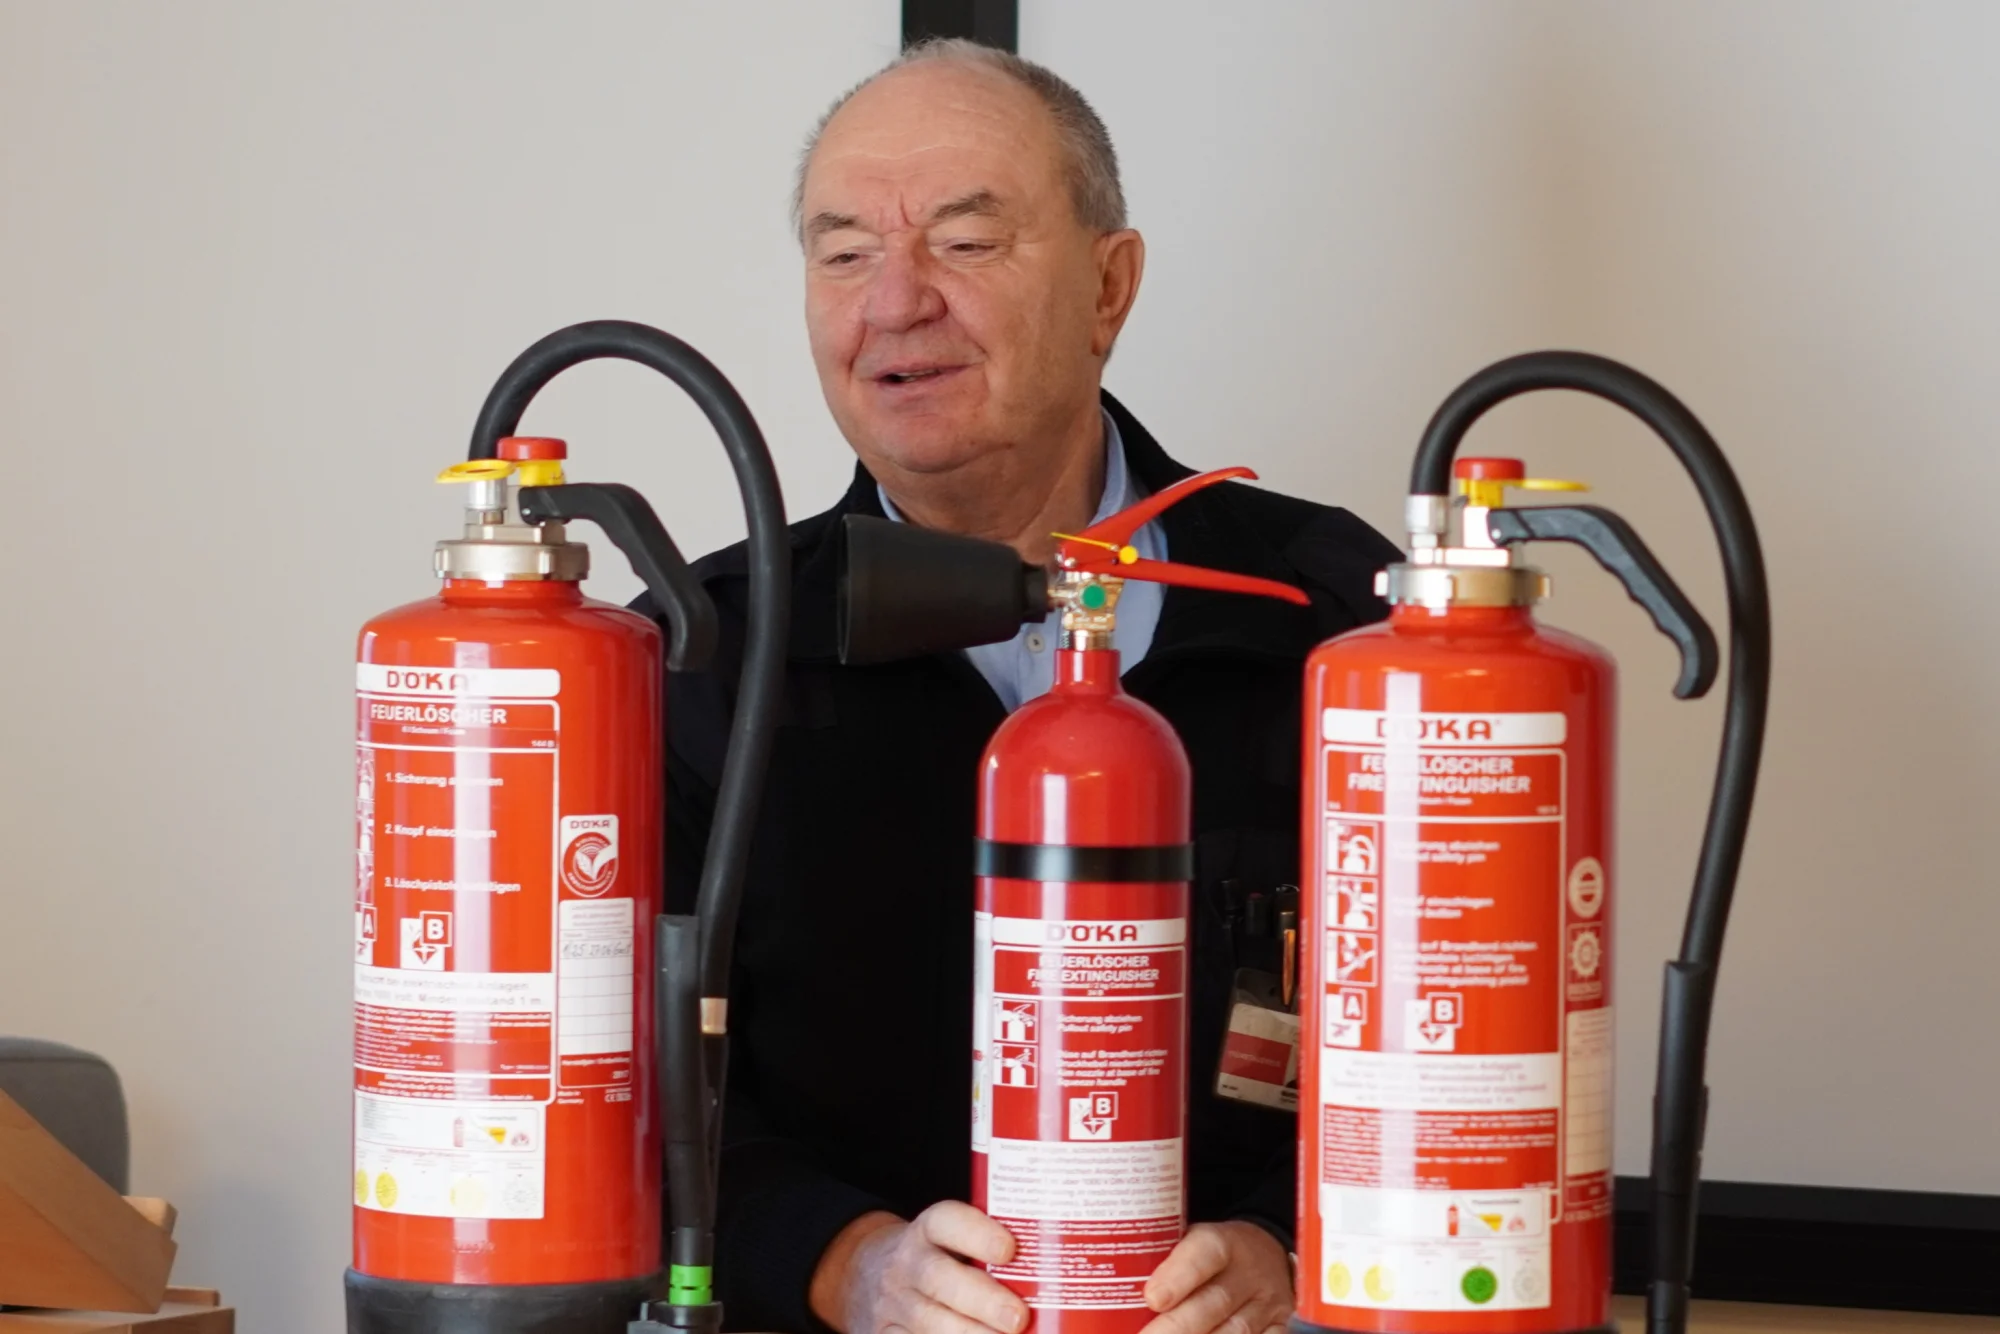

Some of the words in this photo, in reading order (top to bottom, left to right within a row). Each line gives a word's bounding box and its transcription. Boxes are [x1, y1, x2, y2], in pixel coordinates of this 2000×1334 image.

[370, 703, 507, 724] FEUERLÖSCHER
[1361, 753, 1514, 775] FELÖSCHER
[364, 913, 374, 934] A
[426, 918, 445, 940] B
[1039, 954, 1150, 969] FEUERLÖSCHER
[1027, 968, 1059, 981] FIRE
[1062, 968, 1160, 982] EXTINGUISHER
[1344, 995, 1361, 1017] A
[1434, 999, 1455, 1022] B
[1096, 1097, 1111, 1115] B
